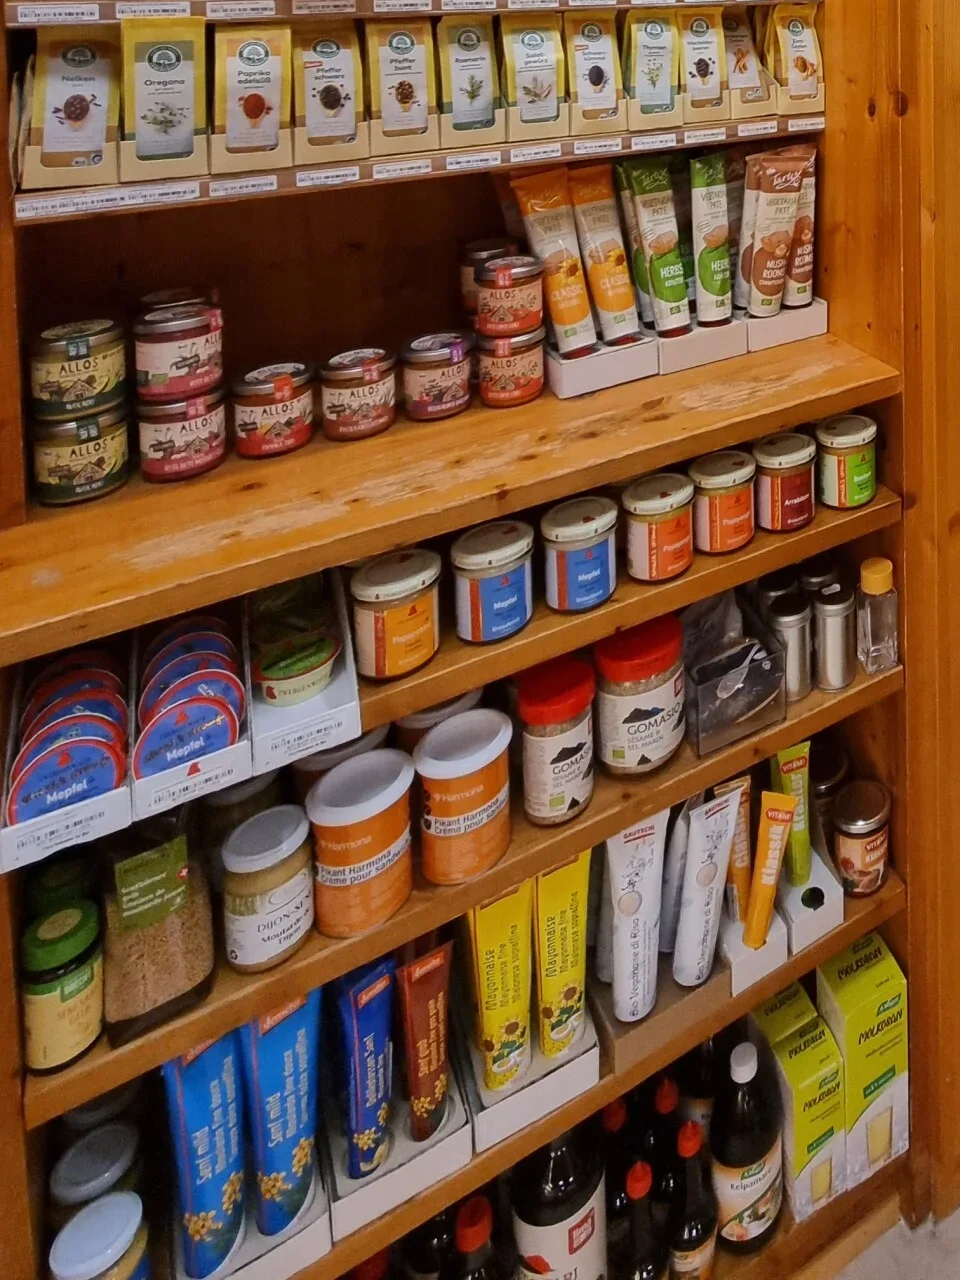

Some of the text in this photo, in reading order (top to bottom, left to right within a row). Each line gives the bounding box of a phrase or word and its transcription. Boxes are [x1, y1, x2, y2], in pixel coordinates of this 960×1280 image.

[61, 75, 96, 83] Nelken
[237, 70, 271, 78] Paprika
[144, 78, 186, 88] Oregano
[489, 288, 516, 301] ALLOS
[60, 358, 99, 375] ALLOS
[490, 357, 517, 370] ALLOS
[349, 384, 380, 400] ALLOS
[261, 402, 295, 418] ALLOS
[180, 416, 213, 434] ALLOS
[70, 440, 109, 458] ALLOS
[627, 702, 681, 737] GOMASIO
[167, 737, 206, 761] Mepfel
[47, 780, 88, 805] Mepfel
[442, 784, 485, 802] Harmona
[434, 798, 500, 828] Pikant Harmona
[463, 817, 484, 834] pour
[327, 835, 373, 851] Harmona
[321, 850, 391, 877] Pikant Harmona
[350, 870, 373, 885] pour
[545, 916, 556, 978] Mayonnaise
[485, 949, 496, 1011] Mayonnaise
[859, 1009, 903, 1045] MOLKOSAN
